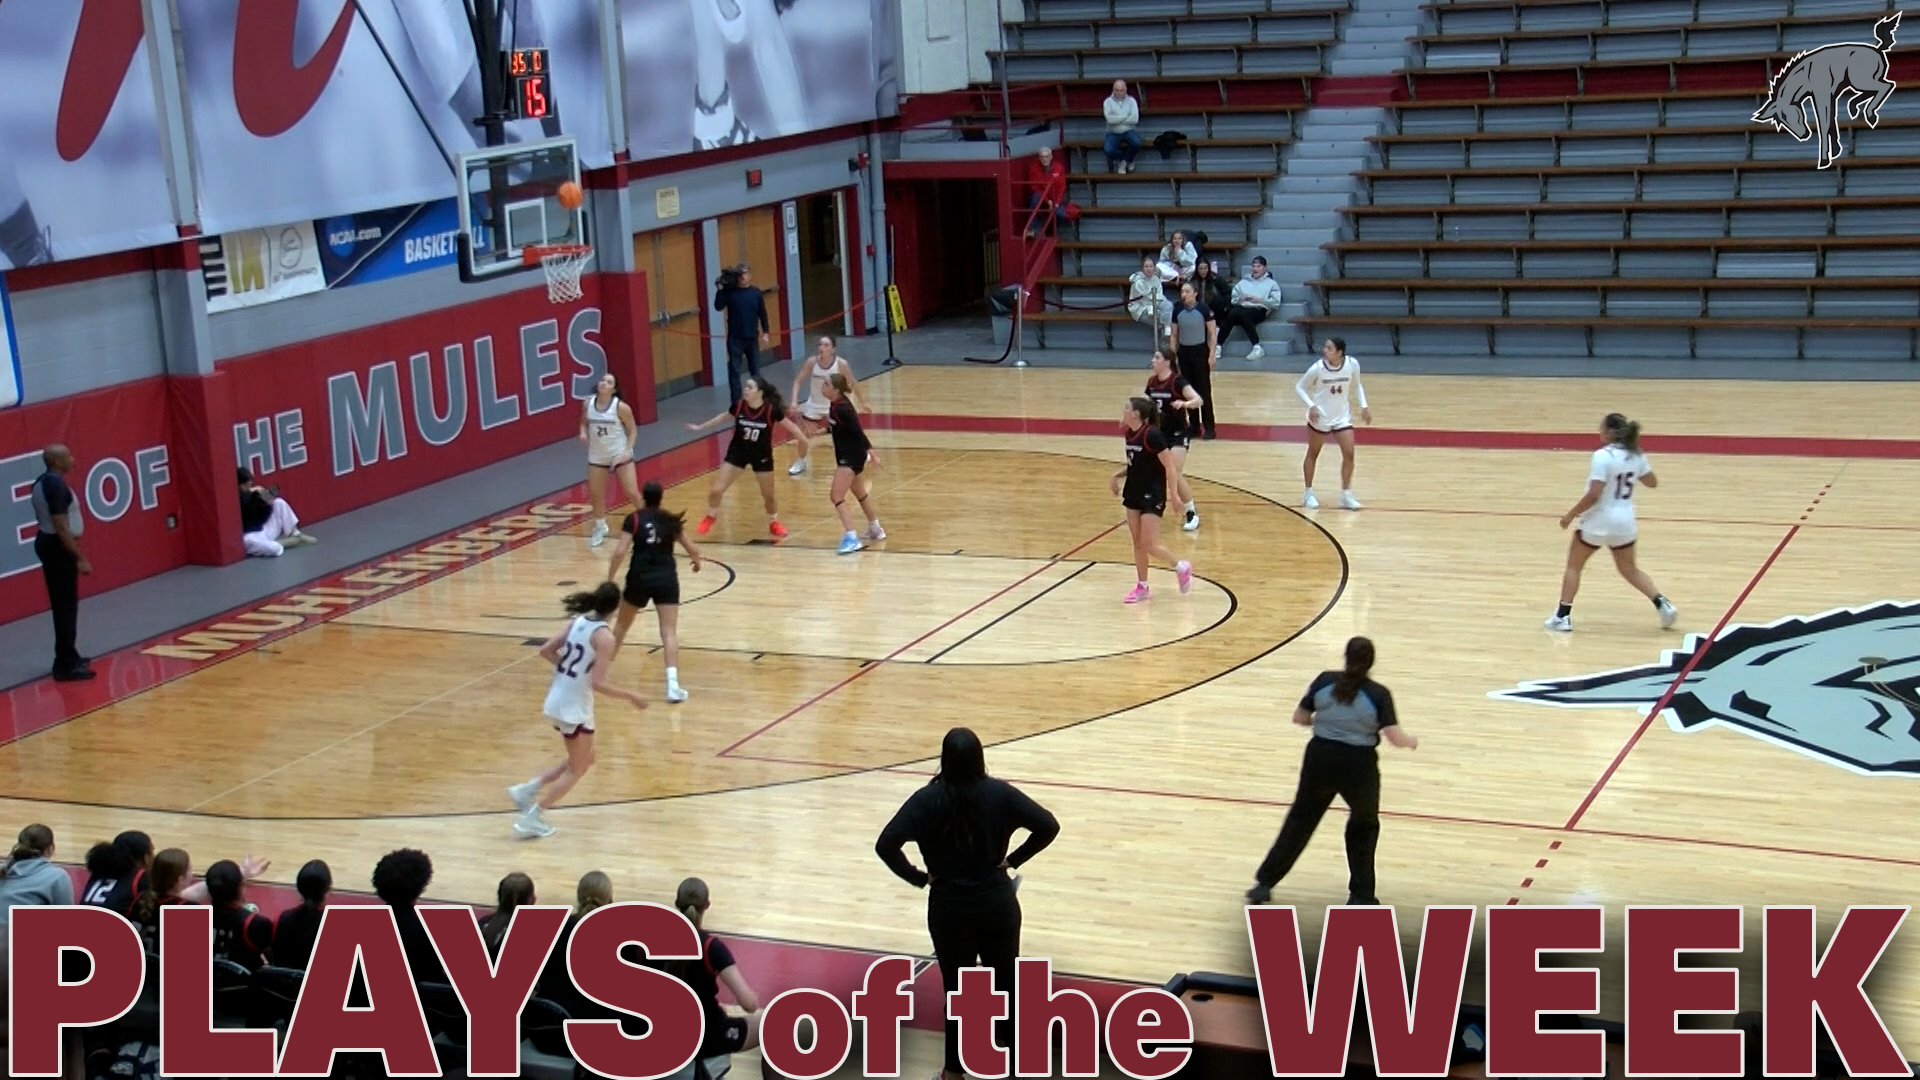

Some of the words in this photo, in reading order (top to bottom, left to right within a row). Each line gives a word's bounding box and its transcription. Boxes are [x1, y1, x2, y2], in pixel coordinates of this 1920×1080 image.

[526, 79, 546, 116] 15
[405, 225, 486, 264] BASKETLL
[85, 444, 171, 522] OF
[233, 408, 308, 476] HE
[327, 307, 608, 476] MULES
[1614, 471, 1634, 500] 15
[142, 502, 593, 660] MUHLENBERG
[557, 641, 585, 678] 22
[84, 879, 118, 903] 12
